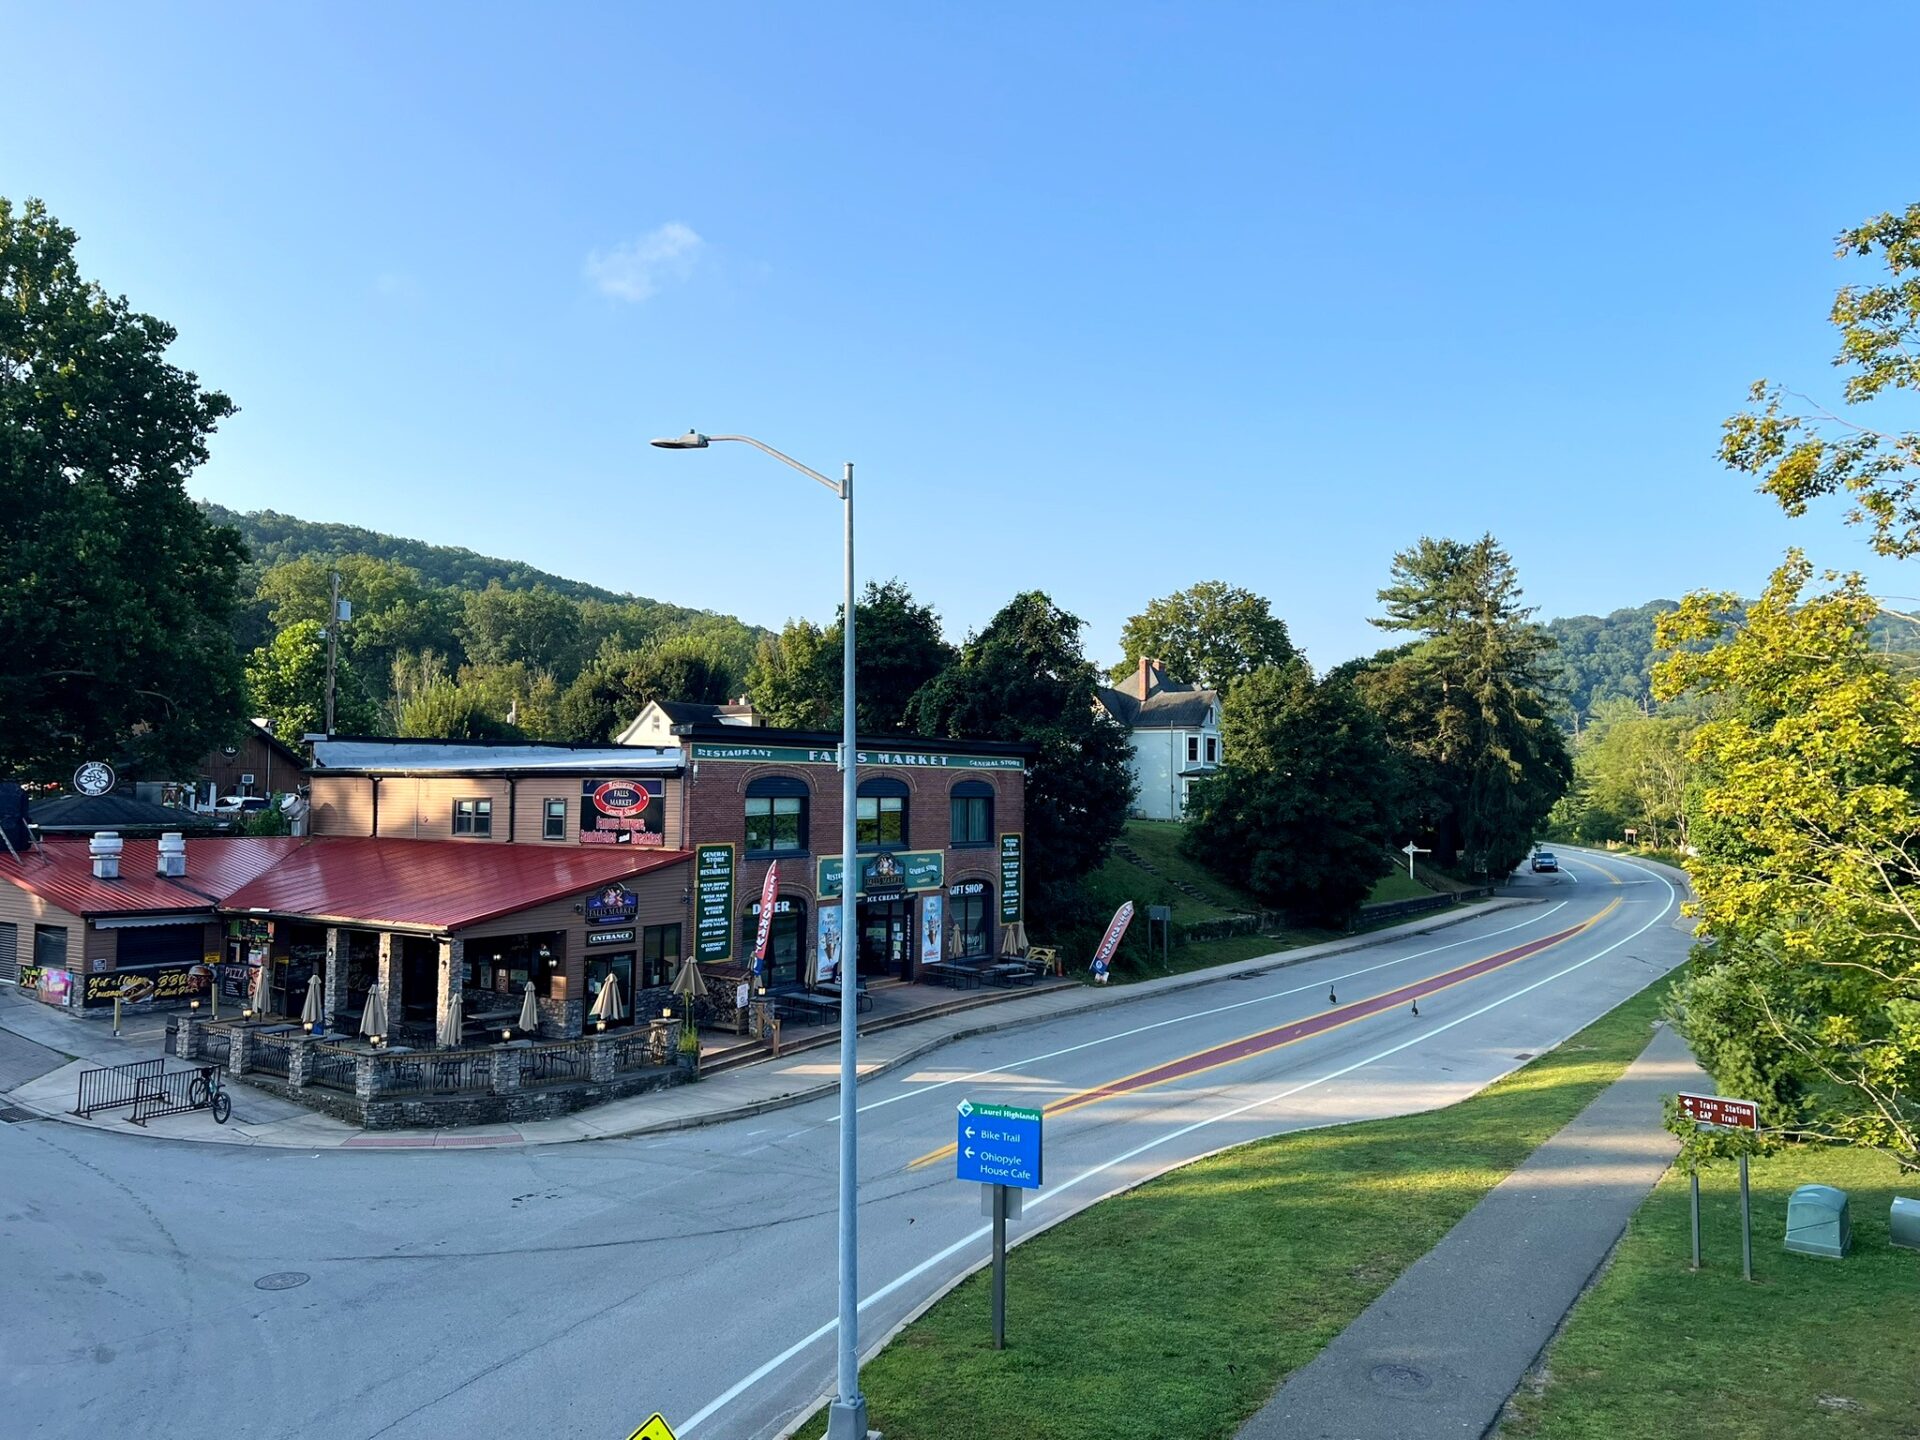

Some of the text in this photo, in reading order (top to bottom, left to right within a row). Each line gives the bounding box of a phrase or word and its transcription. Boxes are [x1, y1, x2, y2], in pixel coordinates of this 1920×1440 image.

[697, 748, 772, 758] RESTAURANT
[808, 750, 948, 767] FAS MARKET
[613, 789, 630, 798] FALLS
[609, 798, 632, 807] MARKET
[950, 883, 984, 895] GIFT SHOP
[878, 894, 900, 902] CREAM
[609, 906, 635, 915] MARKET
[753, 901, 790, 915] DER
[592, 933, 629, 942] ENTRANCE
[225, 966, 248, 980] PIZZA
[89, 977, 111, 988] Hot
[157, 974, 187, 987] BBQ
[980, 1107, 1039, 1121] Laurel Highlands
[1699, 1100, 1751, 1116] Train Station
[1721, 1114, 1738, 1123] Trail
[981, 1130, 1020, 1142] Bike Trail
[980, 1151, 1022, 1165] Ohiopyle
[980, 1165, 1031, 1180] House Cafe
